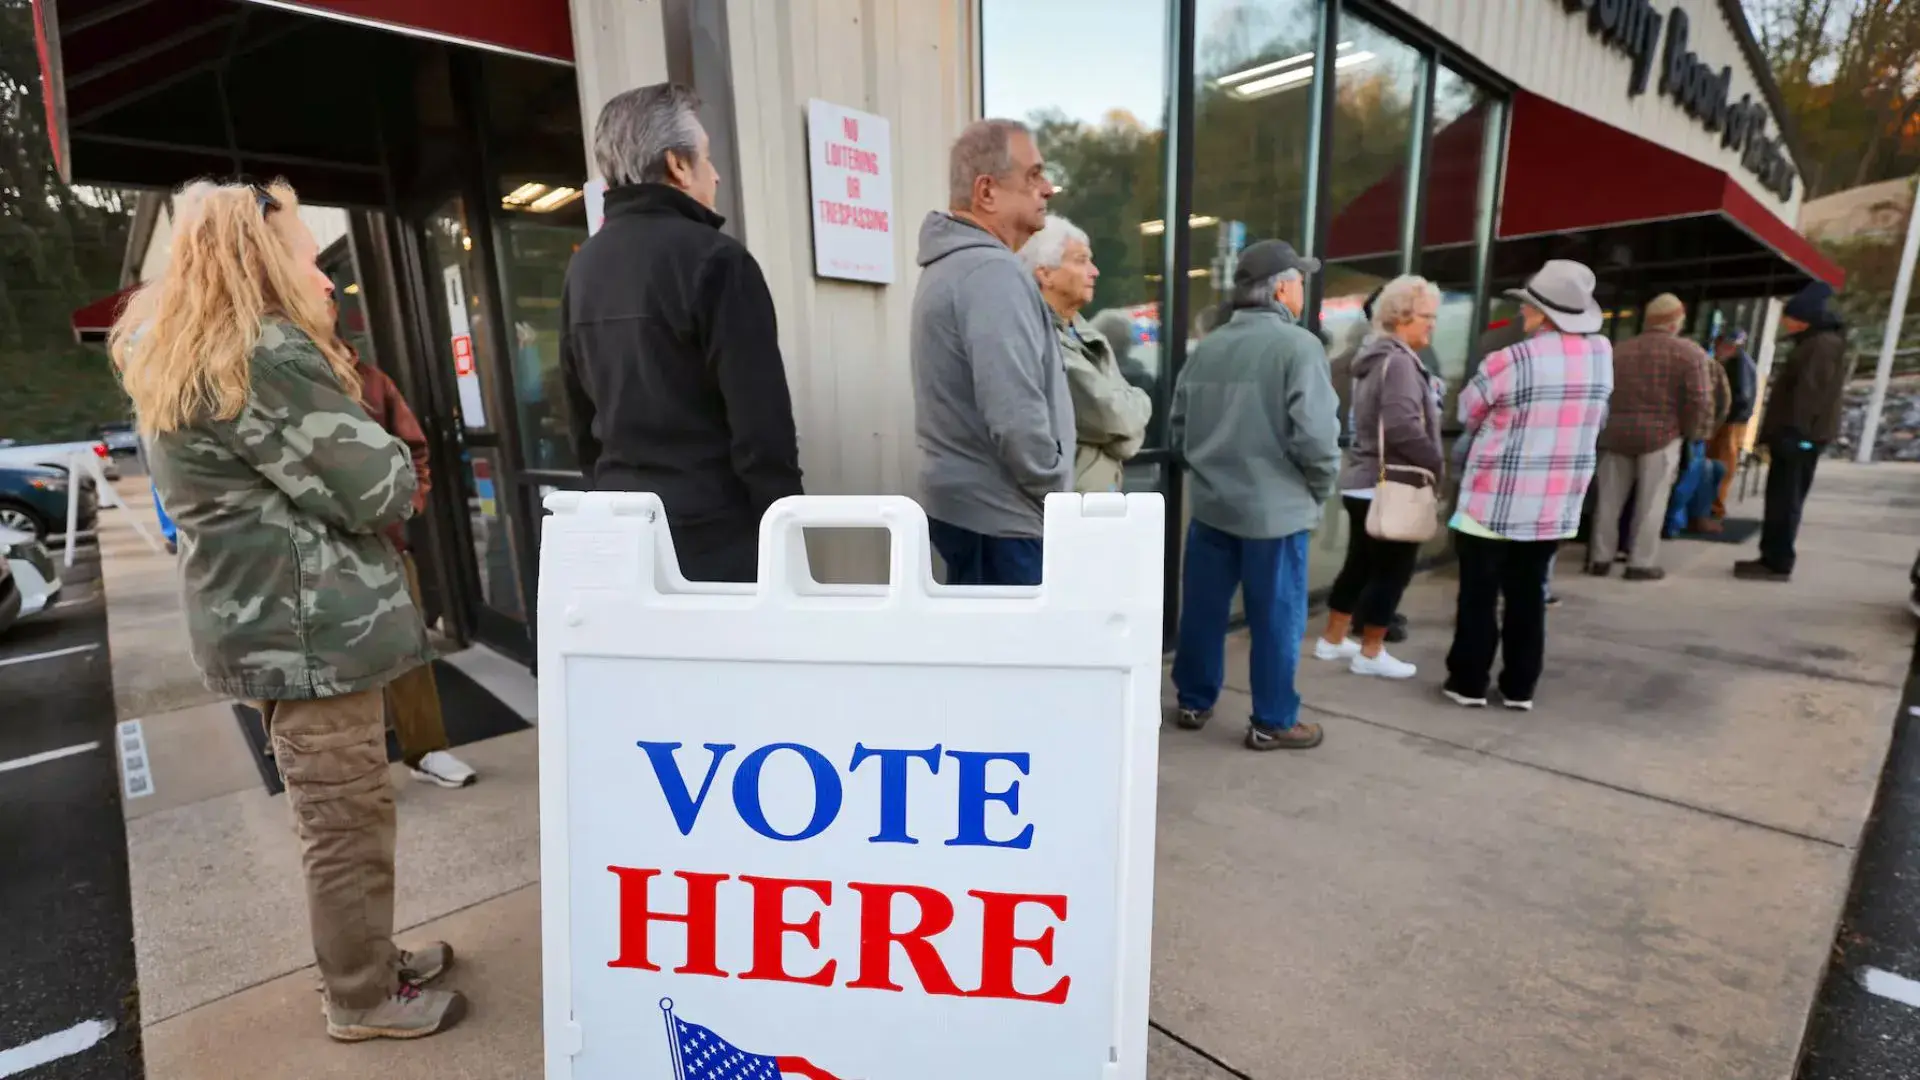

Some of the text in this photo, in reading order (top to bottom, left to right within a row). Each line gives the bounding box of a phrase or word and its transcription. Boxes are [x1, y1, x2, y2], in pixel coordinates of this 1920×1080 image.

[1657, 6, 1731, 133] Board
[842, 116, 858, 142] NO
[825, 141, 879, 175] LOITERING
[846, 175, 860, 199] OR
[820, 199, 889, 232] TRESPASSING
[637, 740, 1034, 849] VOTE
[606, 865, 1071, 1005] HERE
